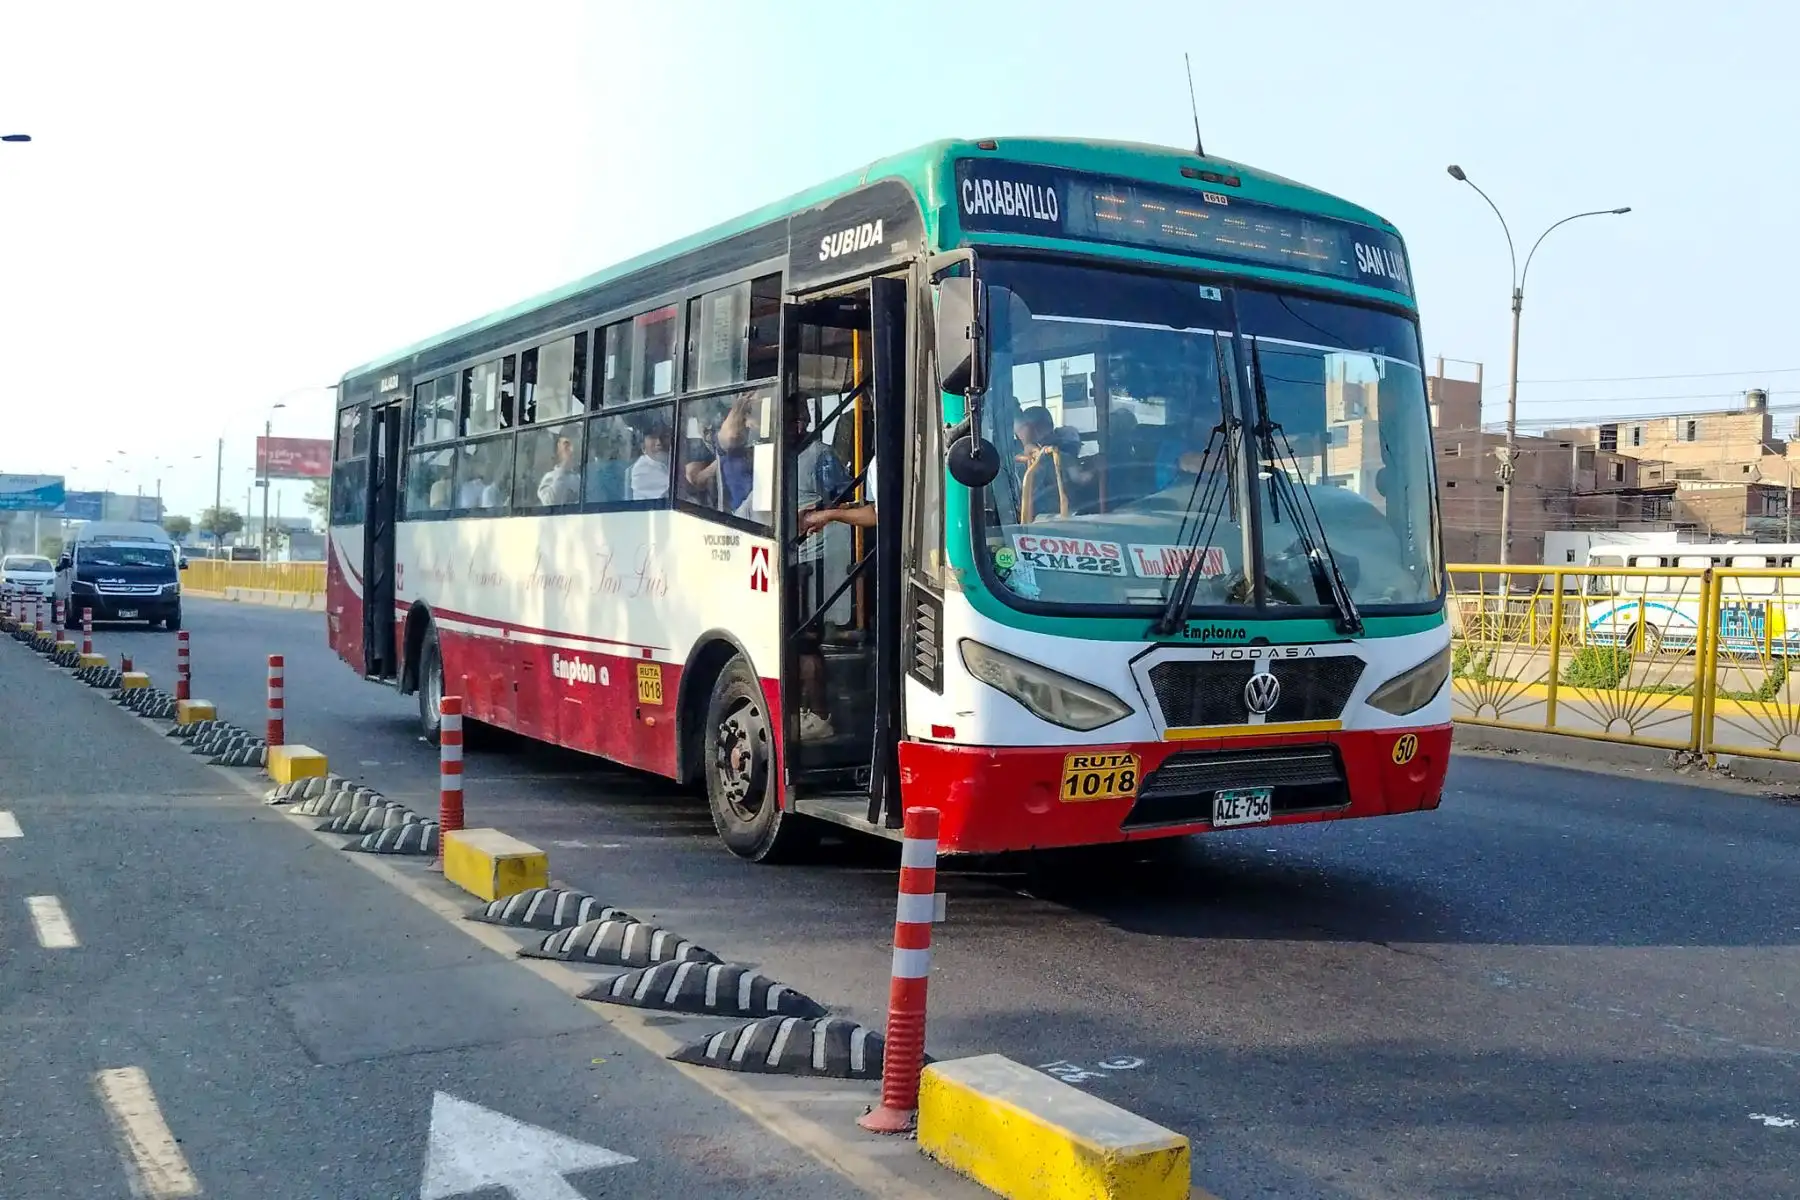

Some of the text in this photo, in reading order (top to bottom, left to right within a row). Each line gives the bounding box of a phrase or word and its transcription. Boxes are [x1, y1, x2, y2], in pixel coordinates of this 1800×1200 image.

[962, 178, 1058, 222] CARABAYLLO
[1205, 193, 1227, 204] 1610
[818, 218, 883, 262] SUBIDA
[1354, 241, 1386, 277] SAN
[703, 534, 740, 546] VOLKSBUS
[1019, 536, 1120, 559] COMAS
[1020, 551, 1074, 570] KM.
[1211, 647, 1316, 660] MODASA
[640, 667, 659, 677] RUTA
[639, 680, 661, 700] 1018
[1396, 735, 1416, 762] 50
[1073, 754, 1134, 769] RUTA
[1065, 770, 1135, 797] 1018
[1216, 795, 1269, 821] AZE-756
